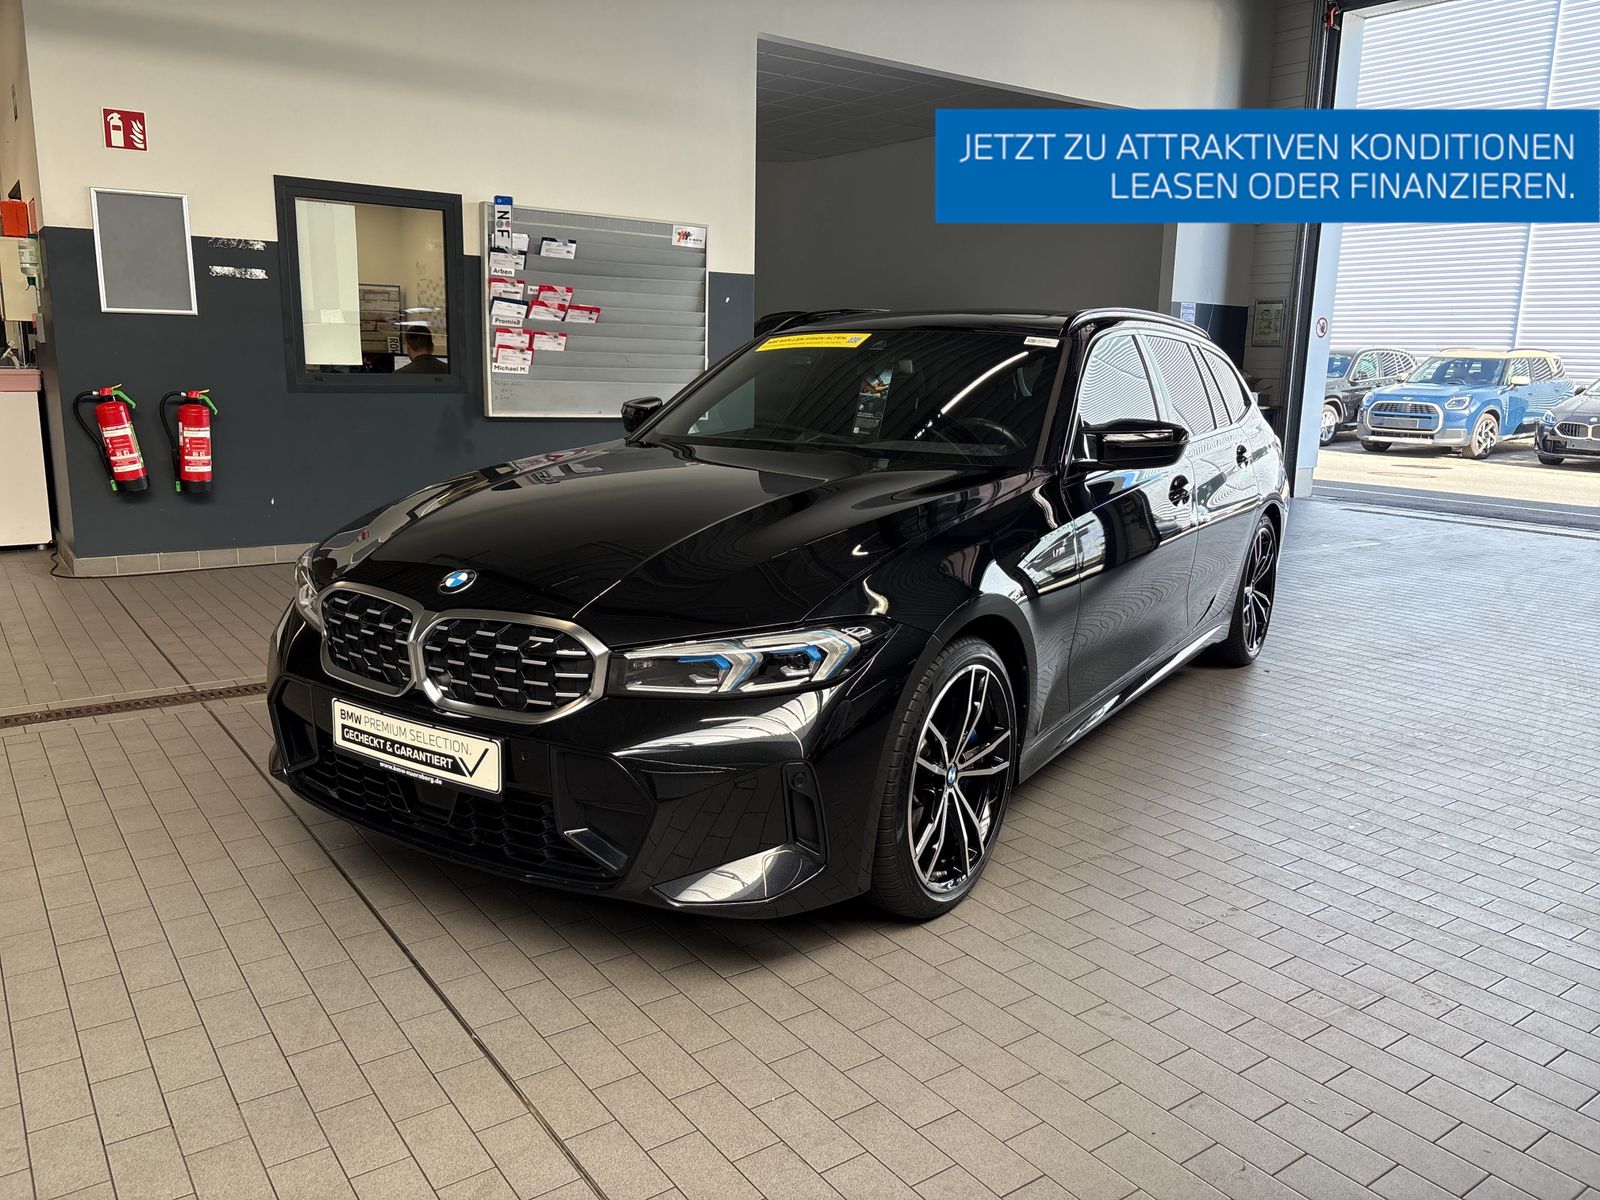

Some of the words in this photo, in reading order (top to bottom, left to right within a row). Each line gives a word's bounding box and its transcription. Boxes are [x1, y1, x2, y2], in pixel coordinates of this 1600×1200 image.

[493, 267, 513, 275] Arben
[494, 364, 519, 373] Michael
[340, 708, 362, 725] BMW
[364, 716, 408, 740] PREMIUM
[409, 728, 472, 757] SELECTION.
[343, 728, 385, 750] GECHECKT
[386, 741, 394, 753] &
[394, 744, 454, 770] GARANTIERT
